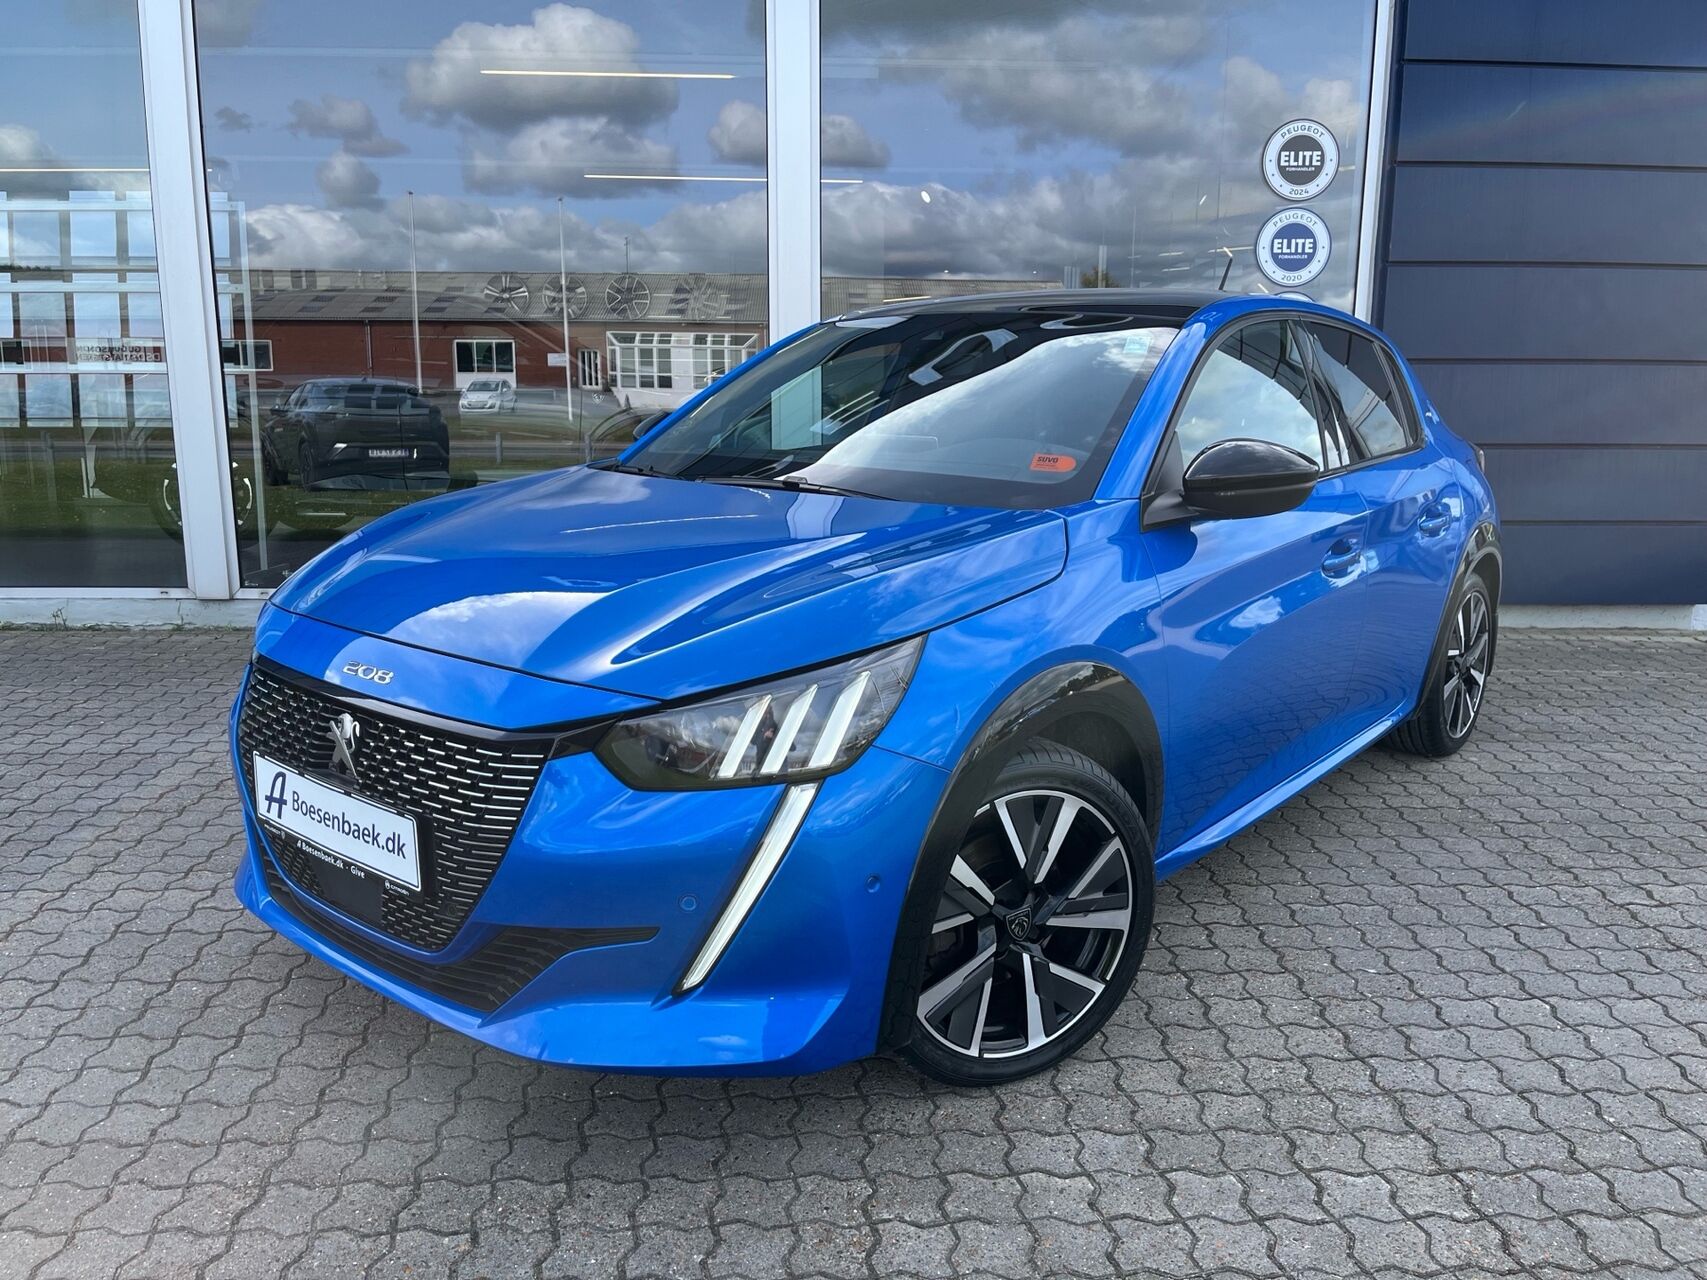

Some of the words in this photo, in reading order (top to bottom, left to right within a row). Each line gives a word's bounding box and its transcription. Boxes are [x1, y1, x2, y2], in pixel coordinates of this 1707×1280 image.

[1280, 124, 1325, 139] PEUGEOT
[1280, 151, 1322, 166] ELITE
[1289, 188, 1309, 196] 2024
[1272, 212, 1318, 227] PEUGEOT
[1273, 238, 1314, 253] ELITE
[1281, 274, 1302, 282] 2020
[342, 660, 394, 685] 208
[292, 790, 406, 859] Boesenbaek.dk
[302, 841, 344, 869] Boesenbaek.dk
[350, 865, 365, 879] Give
